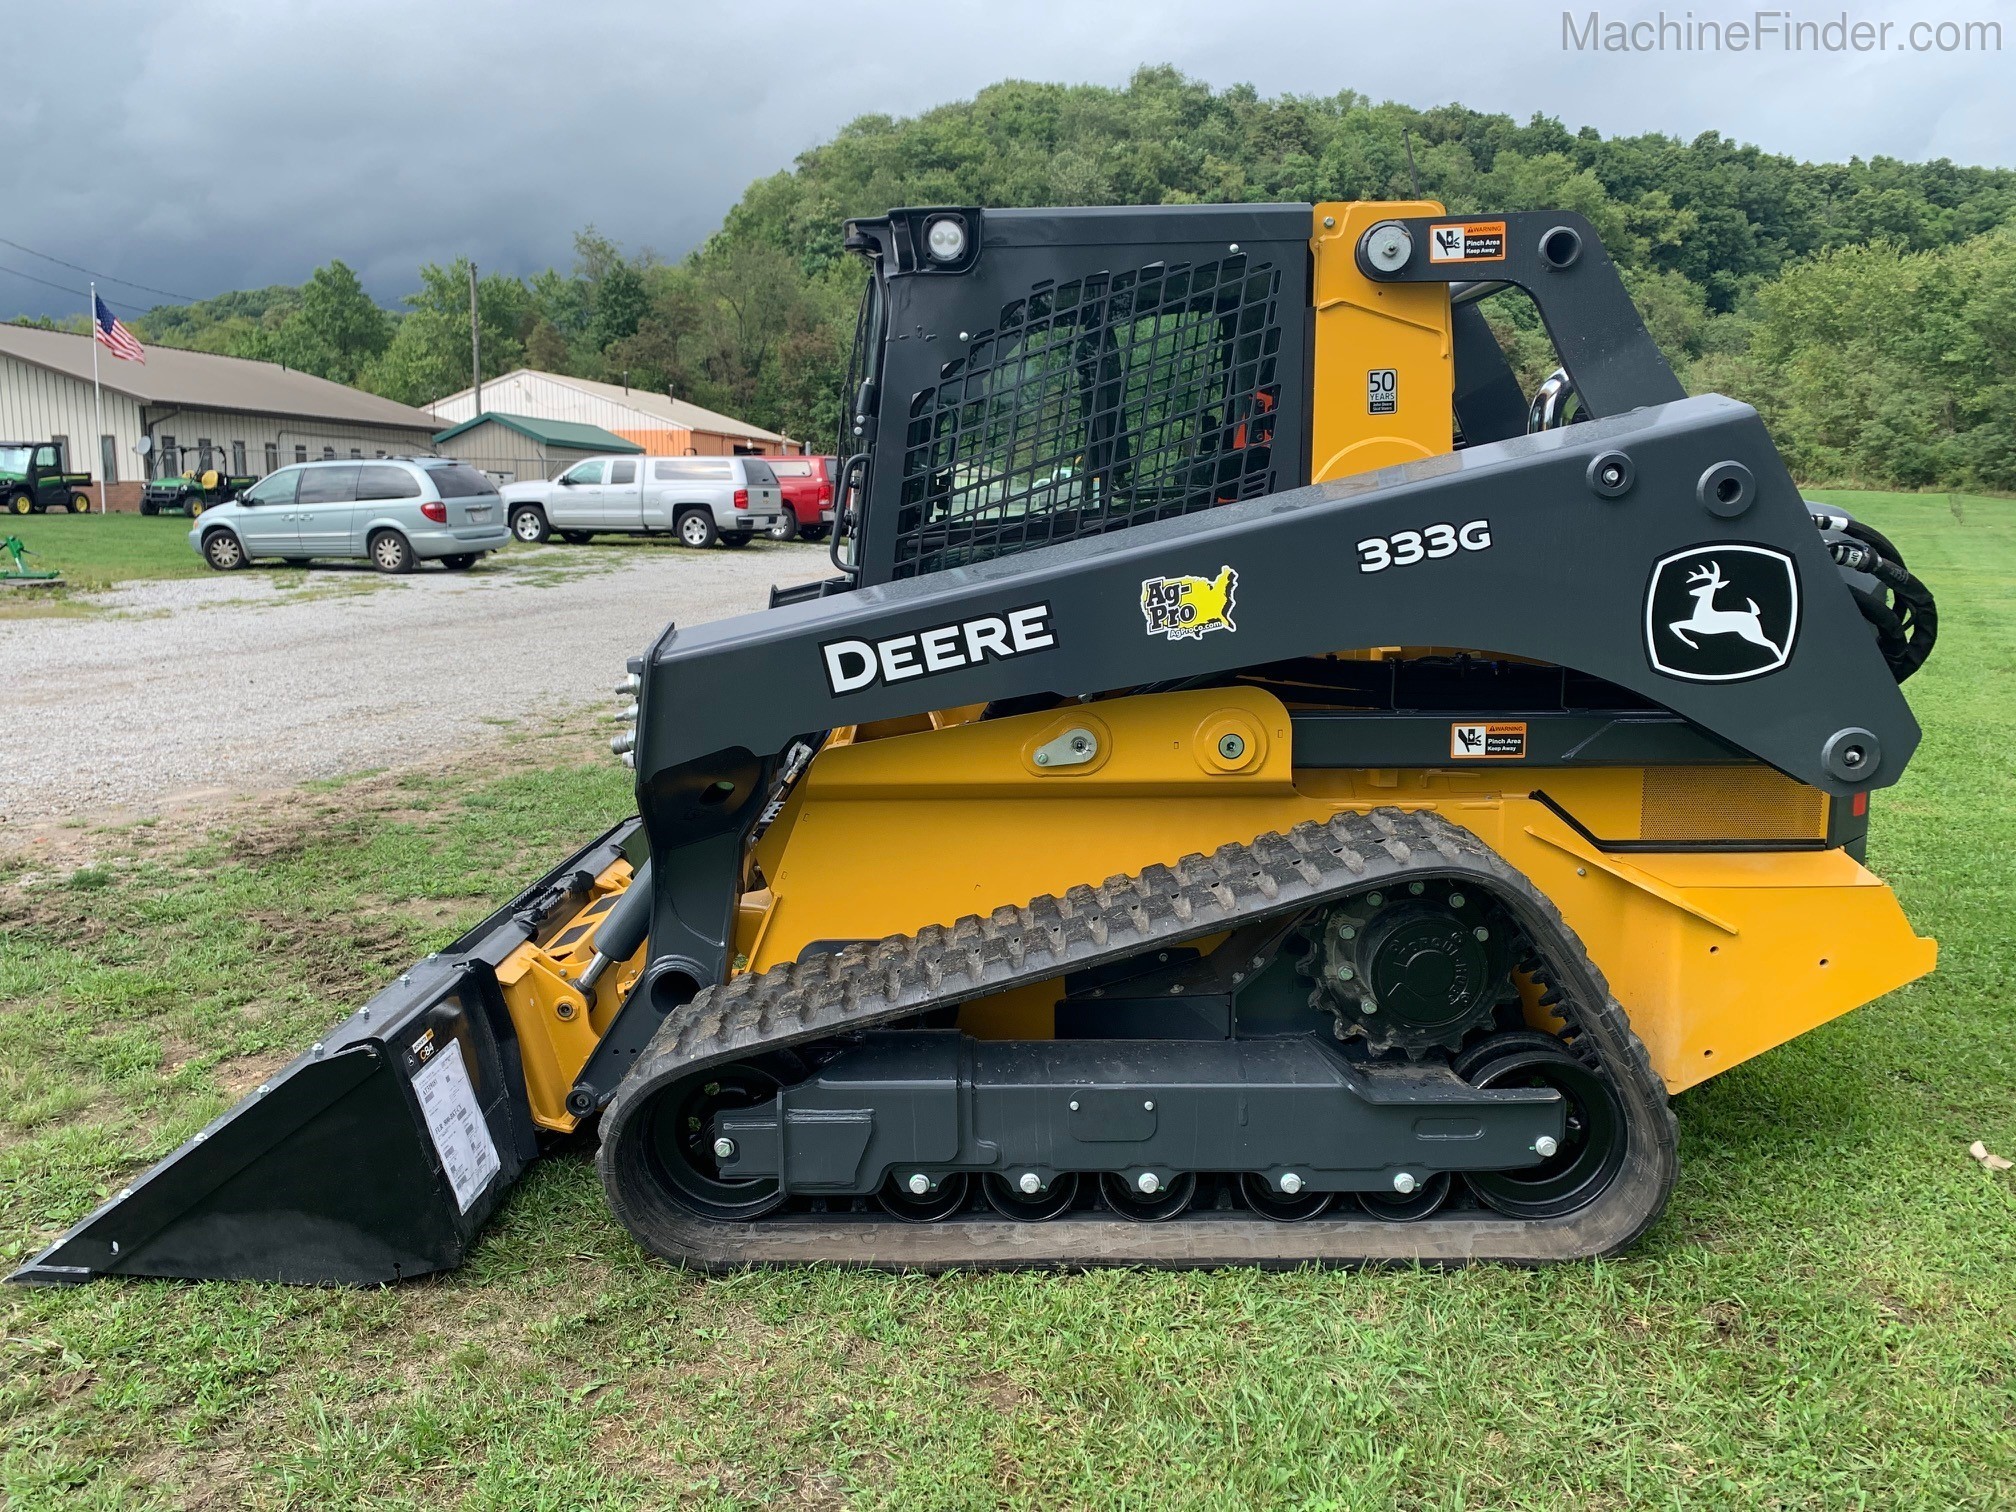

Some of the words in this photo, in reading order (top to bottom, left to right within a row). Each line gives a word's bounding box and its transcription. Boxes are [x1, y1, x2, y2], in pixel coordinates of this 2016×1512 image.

[1473, 225, 1502, 233] WARNING
[1466, 239, 1484, 247] Pinch
[1370, 371, 1395, 393] 50
[1370, 392, 1395, 401] YEARS
[1357, 519, 1492, 573] 333G
[1146, 580, 1191, 608] Ag-
[1149, 604, 1196, 630] Pro
[1170, 621, 1222, 638] AgProCo.com
[823, 604, 1055, 694] DEERE
[420, 1041, 434, 1060] C84
